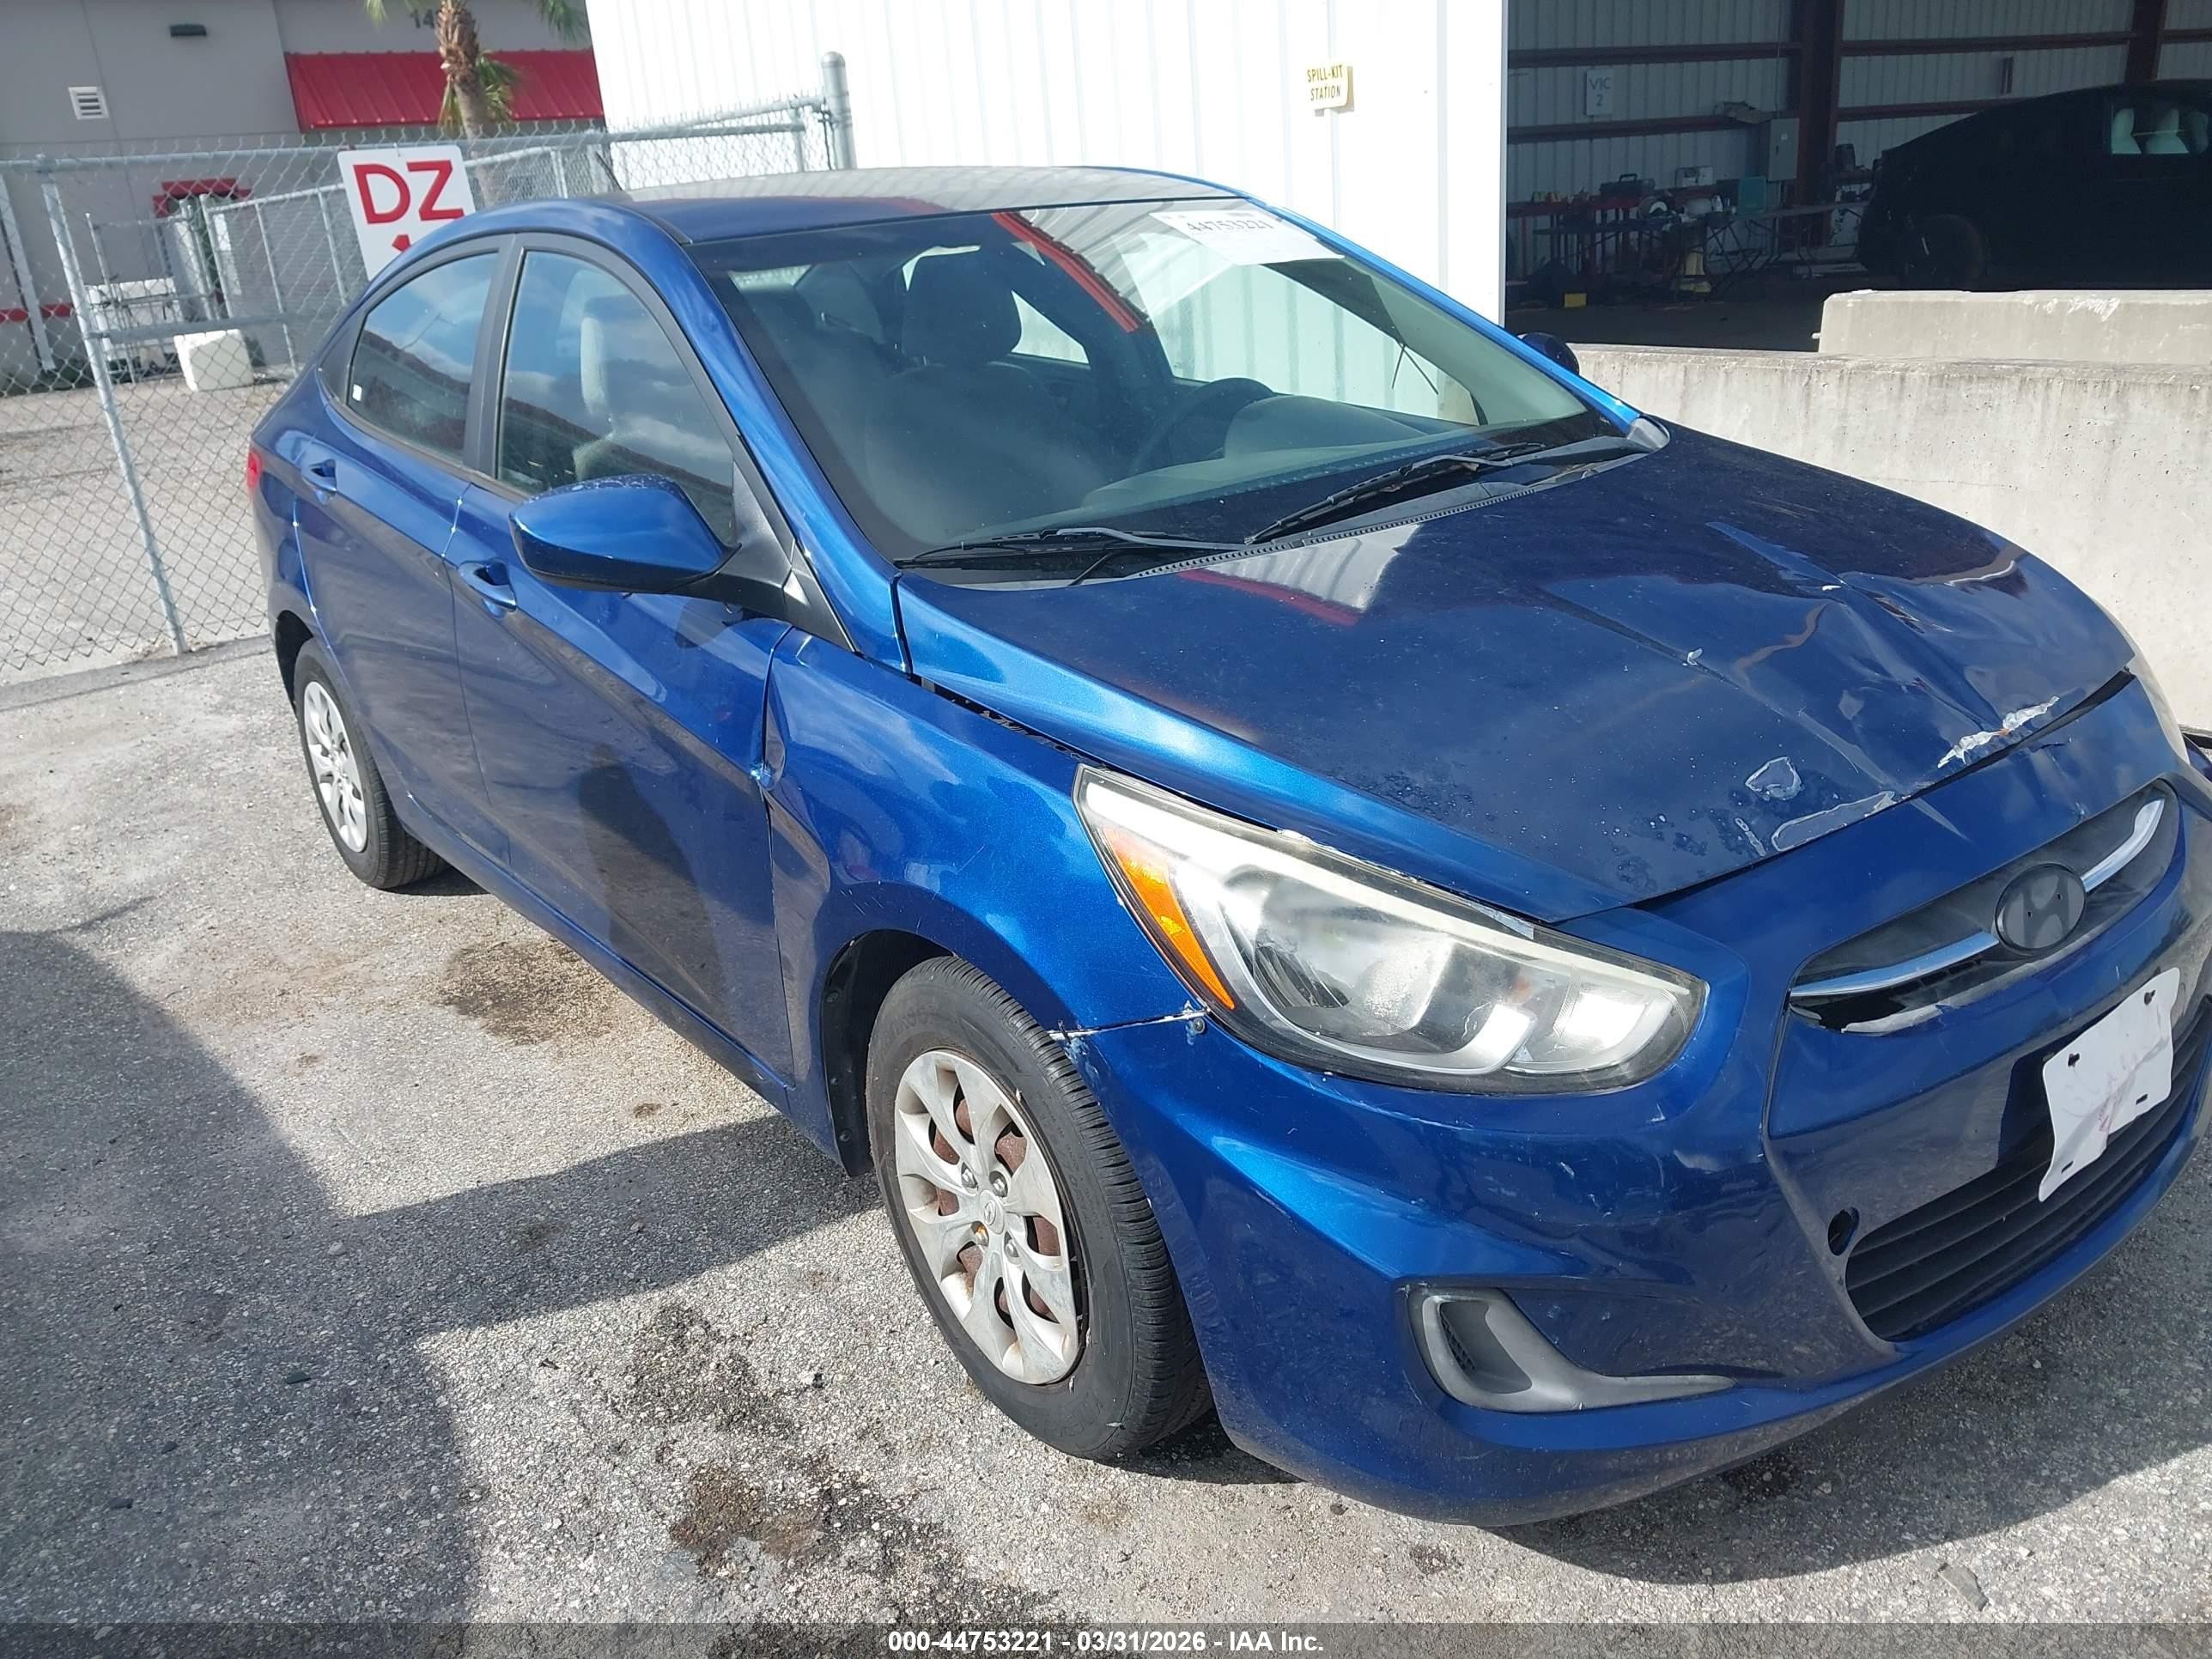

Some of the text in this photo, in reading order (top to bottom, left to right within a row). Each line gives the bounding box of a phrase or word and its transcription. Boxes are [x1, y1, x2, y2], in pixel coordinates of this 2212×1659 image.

[1307, 64, 1343, 83] SPILL-KIT
[1589, 76, 1611, 90] VIC
[1310, 84, 1341, 101] STATION
[1595, 94, 1603, 107] 2
[353, 160, 465, 224] DZ
[1186, 220, 1273, 232] 44753221
